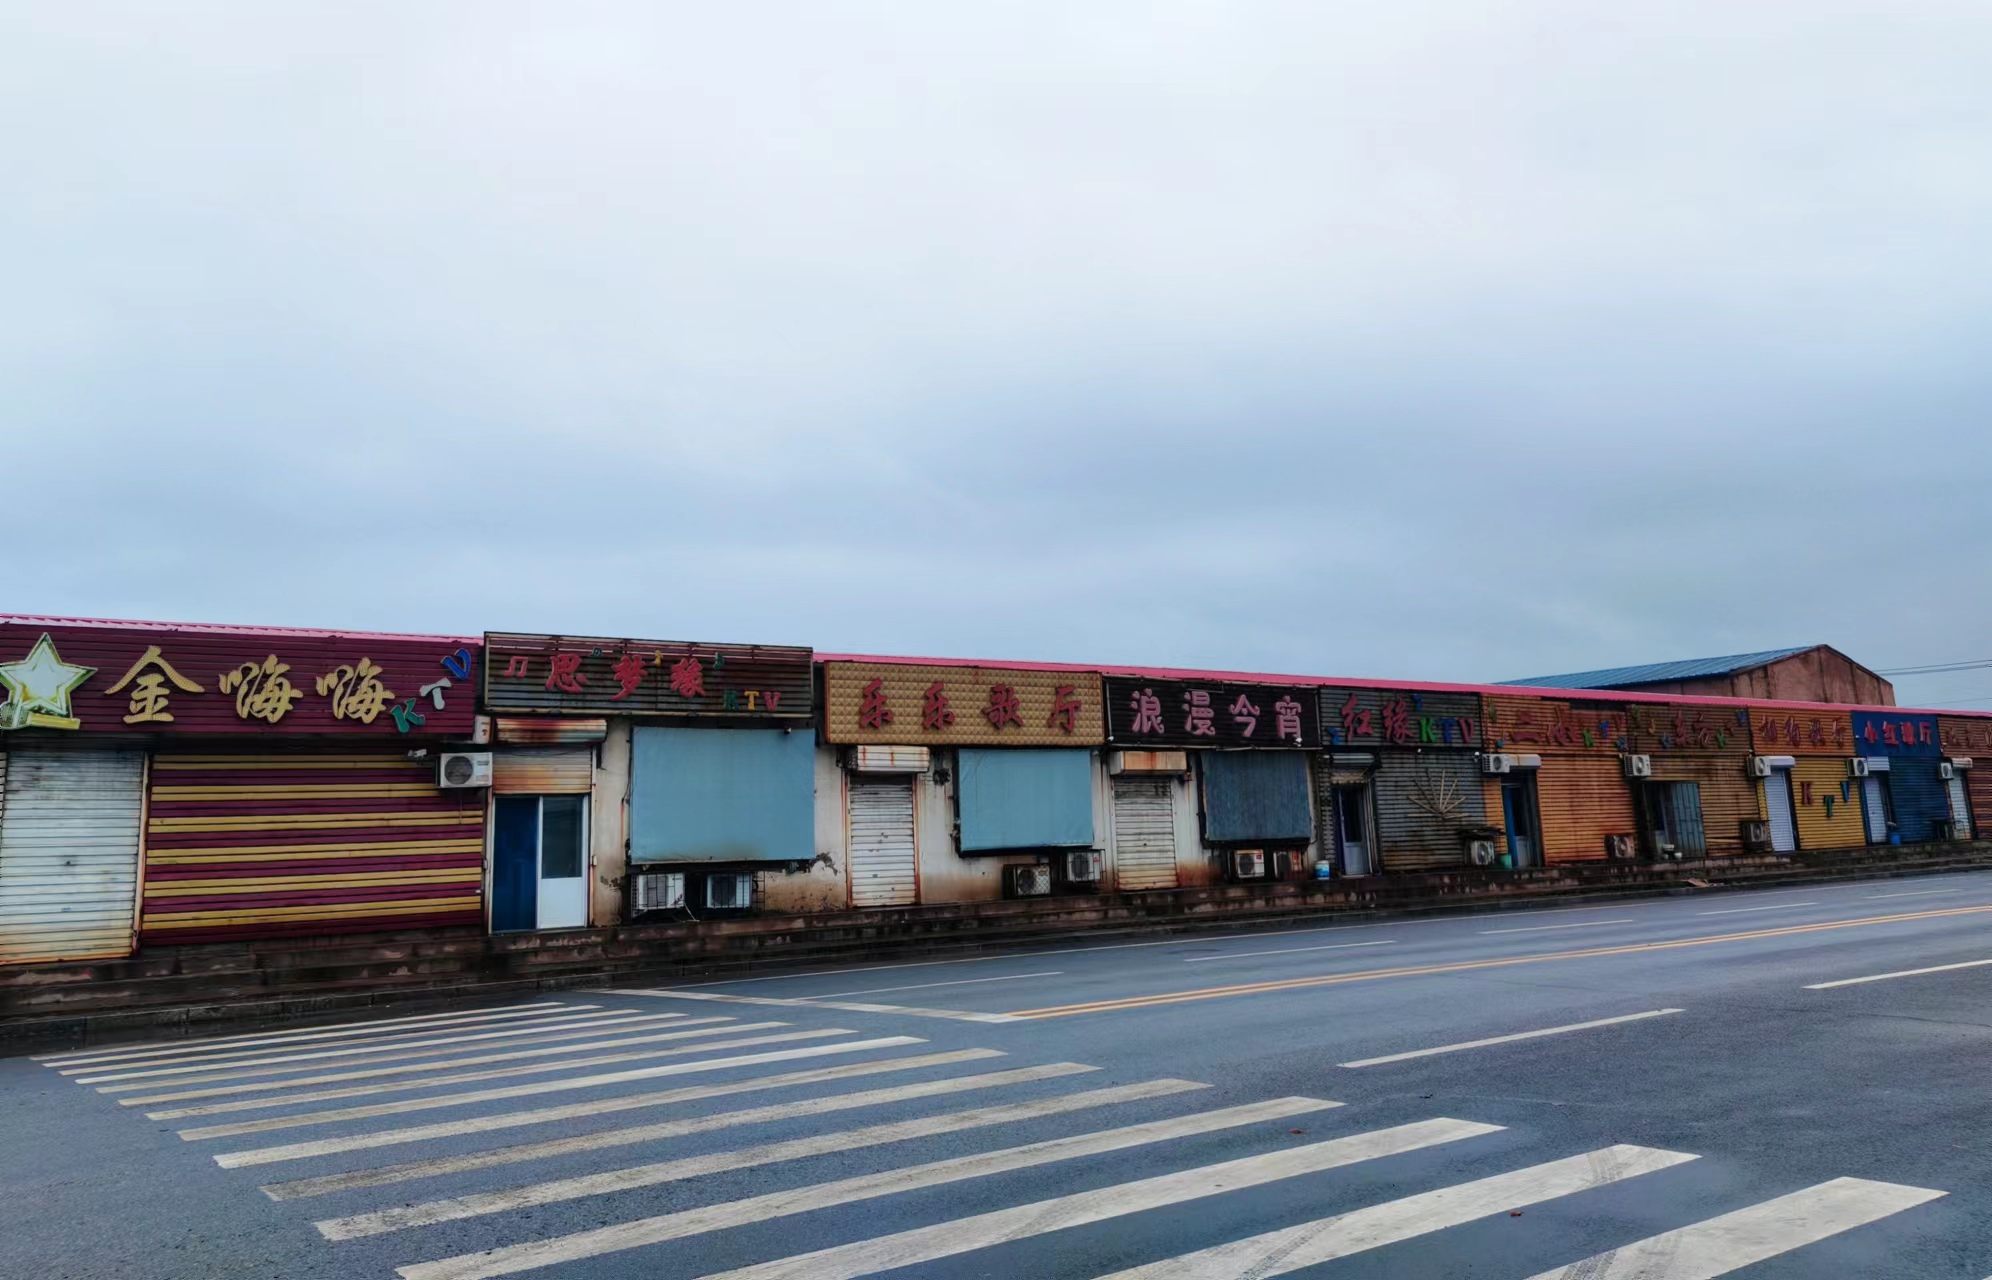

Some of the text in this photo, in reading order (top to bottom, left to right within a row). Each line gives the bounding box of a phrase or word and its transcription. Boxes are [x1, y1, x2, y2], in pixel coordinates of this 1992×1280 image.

[103, 645, 472, 733] 金嗨嗨 KTV
[723, 688, 783, 712] KTV
[859, 676, 1082, 733] 乐乐歌厅
[1128, 687, 1303, 740] 浪漫今宵
[1340, 691, 1476, 745] 红缘 KTV
[1801, 780, 1850, 818] KTV
